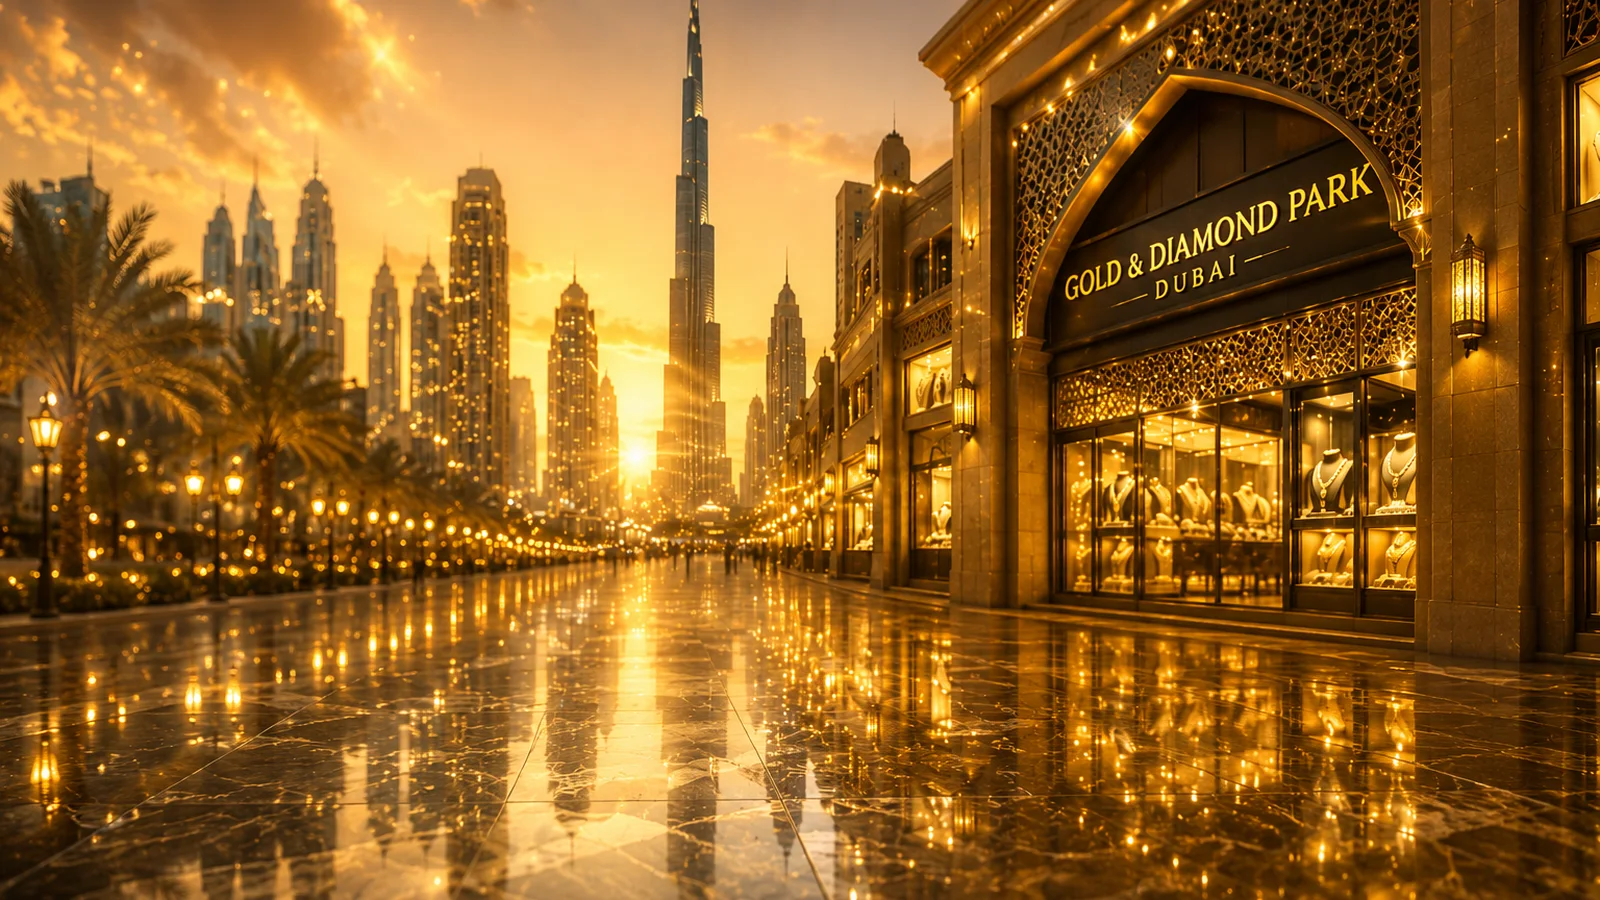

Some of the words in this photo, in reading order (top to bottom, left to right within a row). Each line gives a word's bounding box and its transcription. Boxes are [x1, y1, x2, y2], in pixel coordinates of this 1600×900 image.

[1065, 259, 1121, 300] GOLD
[1127, 253, 1144, 279] &
[1149, 200, 1279, 272] DIAMOND
[1288, 162, 1373, 223] PARK
[1155, 255, 1236, 300] DUBAI
